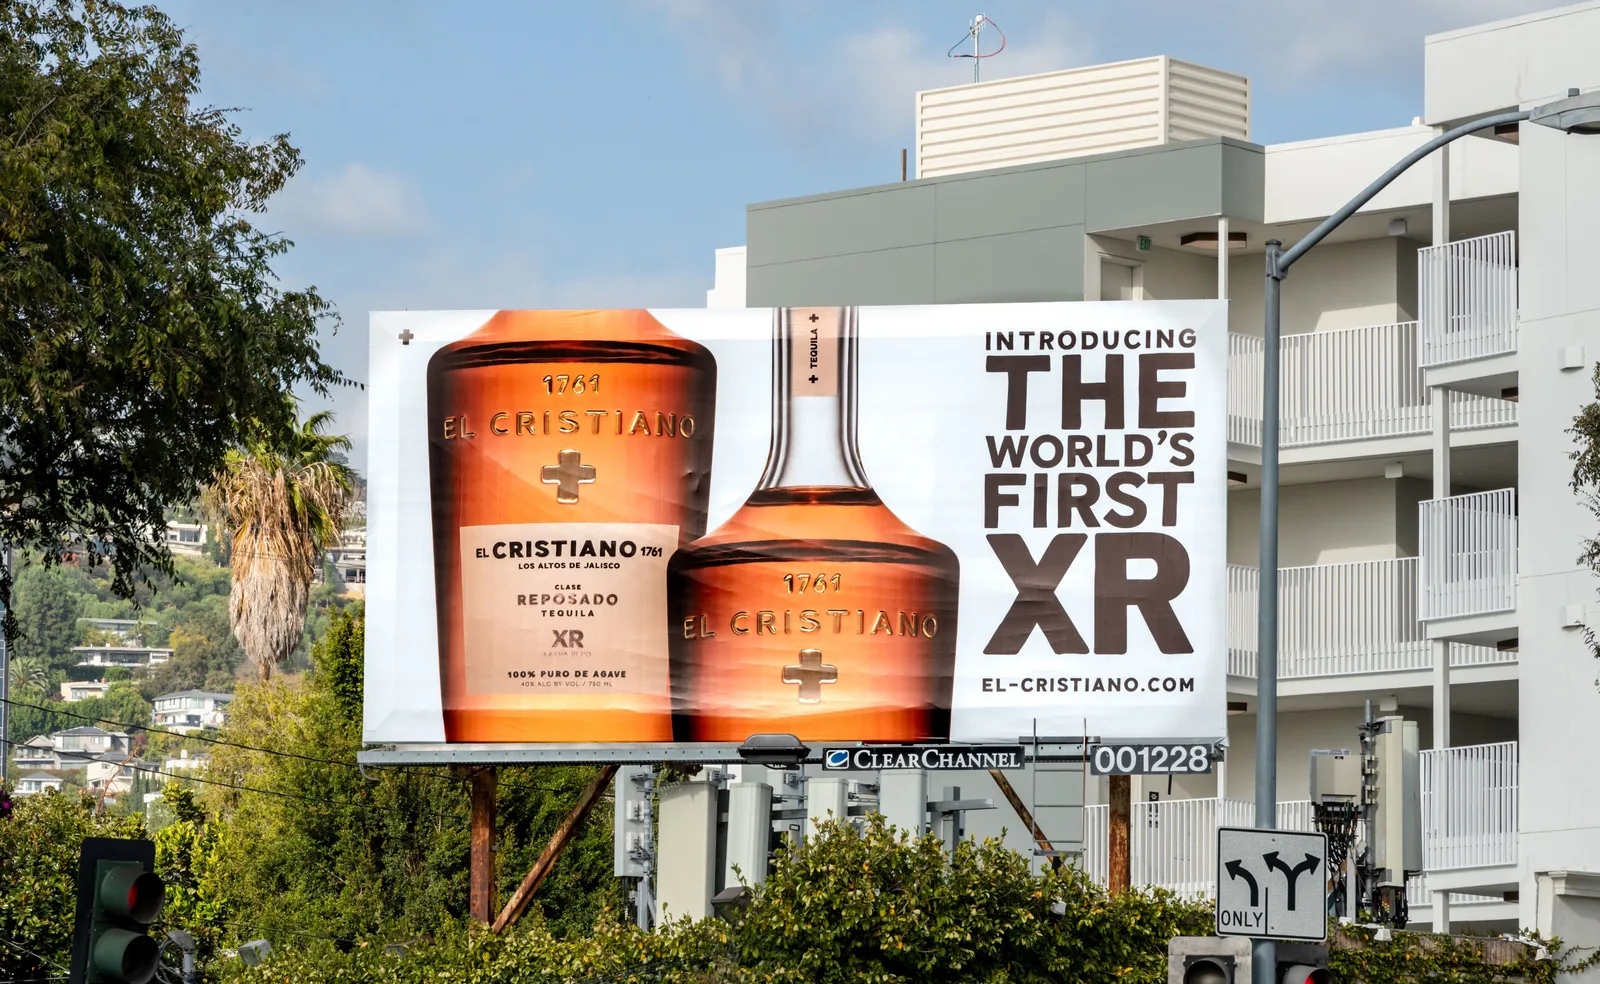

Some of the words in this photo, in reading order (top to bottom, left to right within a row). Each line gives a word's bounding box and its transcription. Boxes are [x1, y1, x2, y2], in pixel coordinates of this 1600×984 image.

[809, 328, 818, 369] TEQUILA
[985, 328, 1197, 351] INTRODUCING
[543, 374, 600, 395] 1761
[985, 352, 1195, 430] THE
[443, 415, 476, 439] EL
[489, 409, 695, 438] CRISTIANO
[984, 471, 1195, 529] FIRST
[475, 548, 489, 558] EL
[492, 540, 637, 558] CRISTIANO
[640, 546, 663, 557] 1761
[584, 562, 621, 570] JALISCO
[783, 573, 841, 594] 1761
[982, 532, 1195, 655] XR
[517, 593, 619, 606] REPOSADO
[541, 609, 595, 617] TEQUILA
[683, 614, 716, 639] EL
[730, 609, 938, 638] CRISTIANO
[551, 629, 584, 648] XR
[982, 677, 1195, 692] EL-CRISTIANO.COM
[1095, 746, 1208, 773] 001228
[1220, 910, 1263, 927] ONLY
